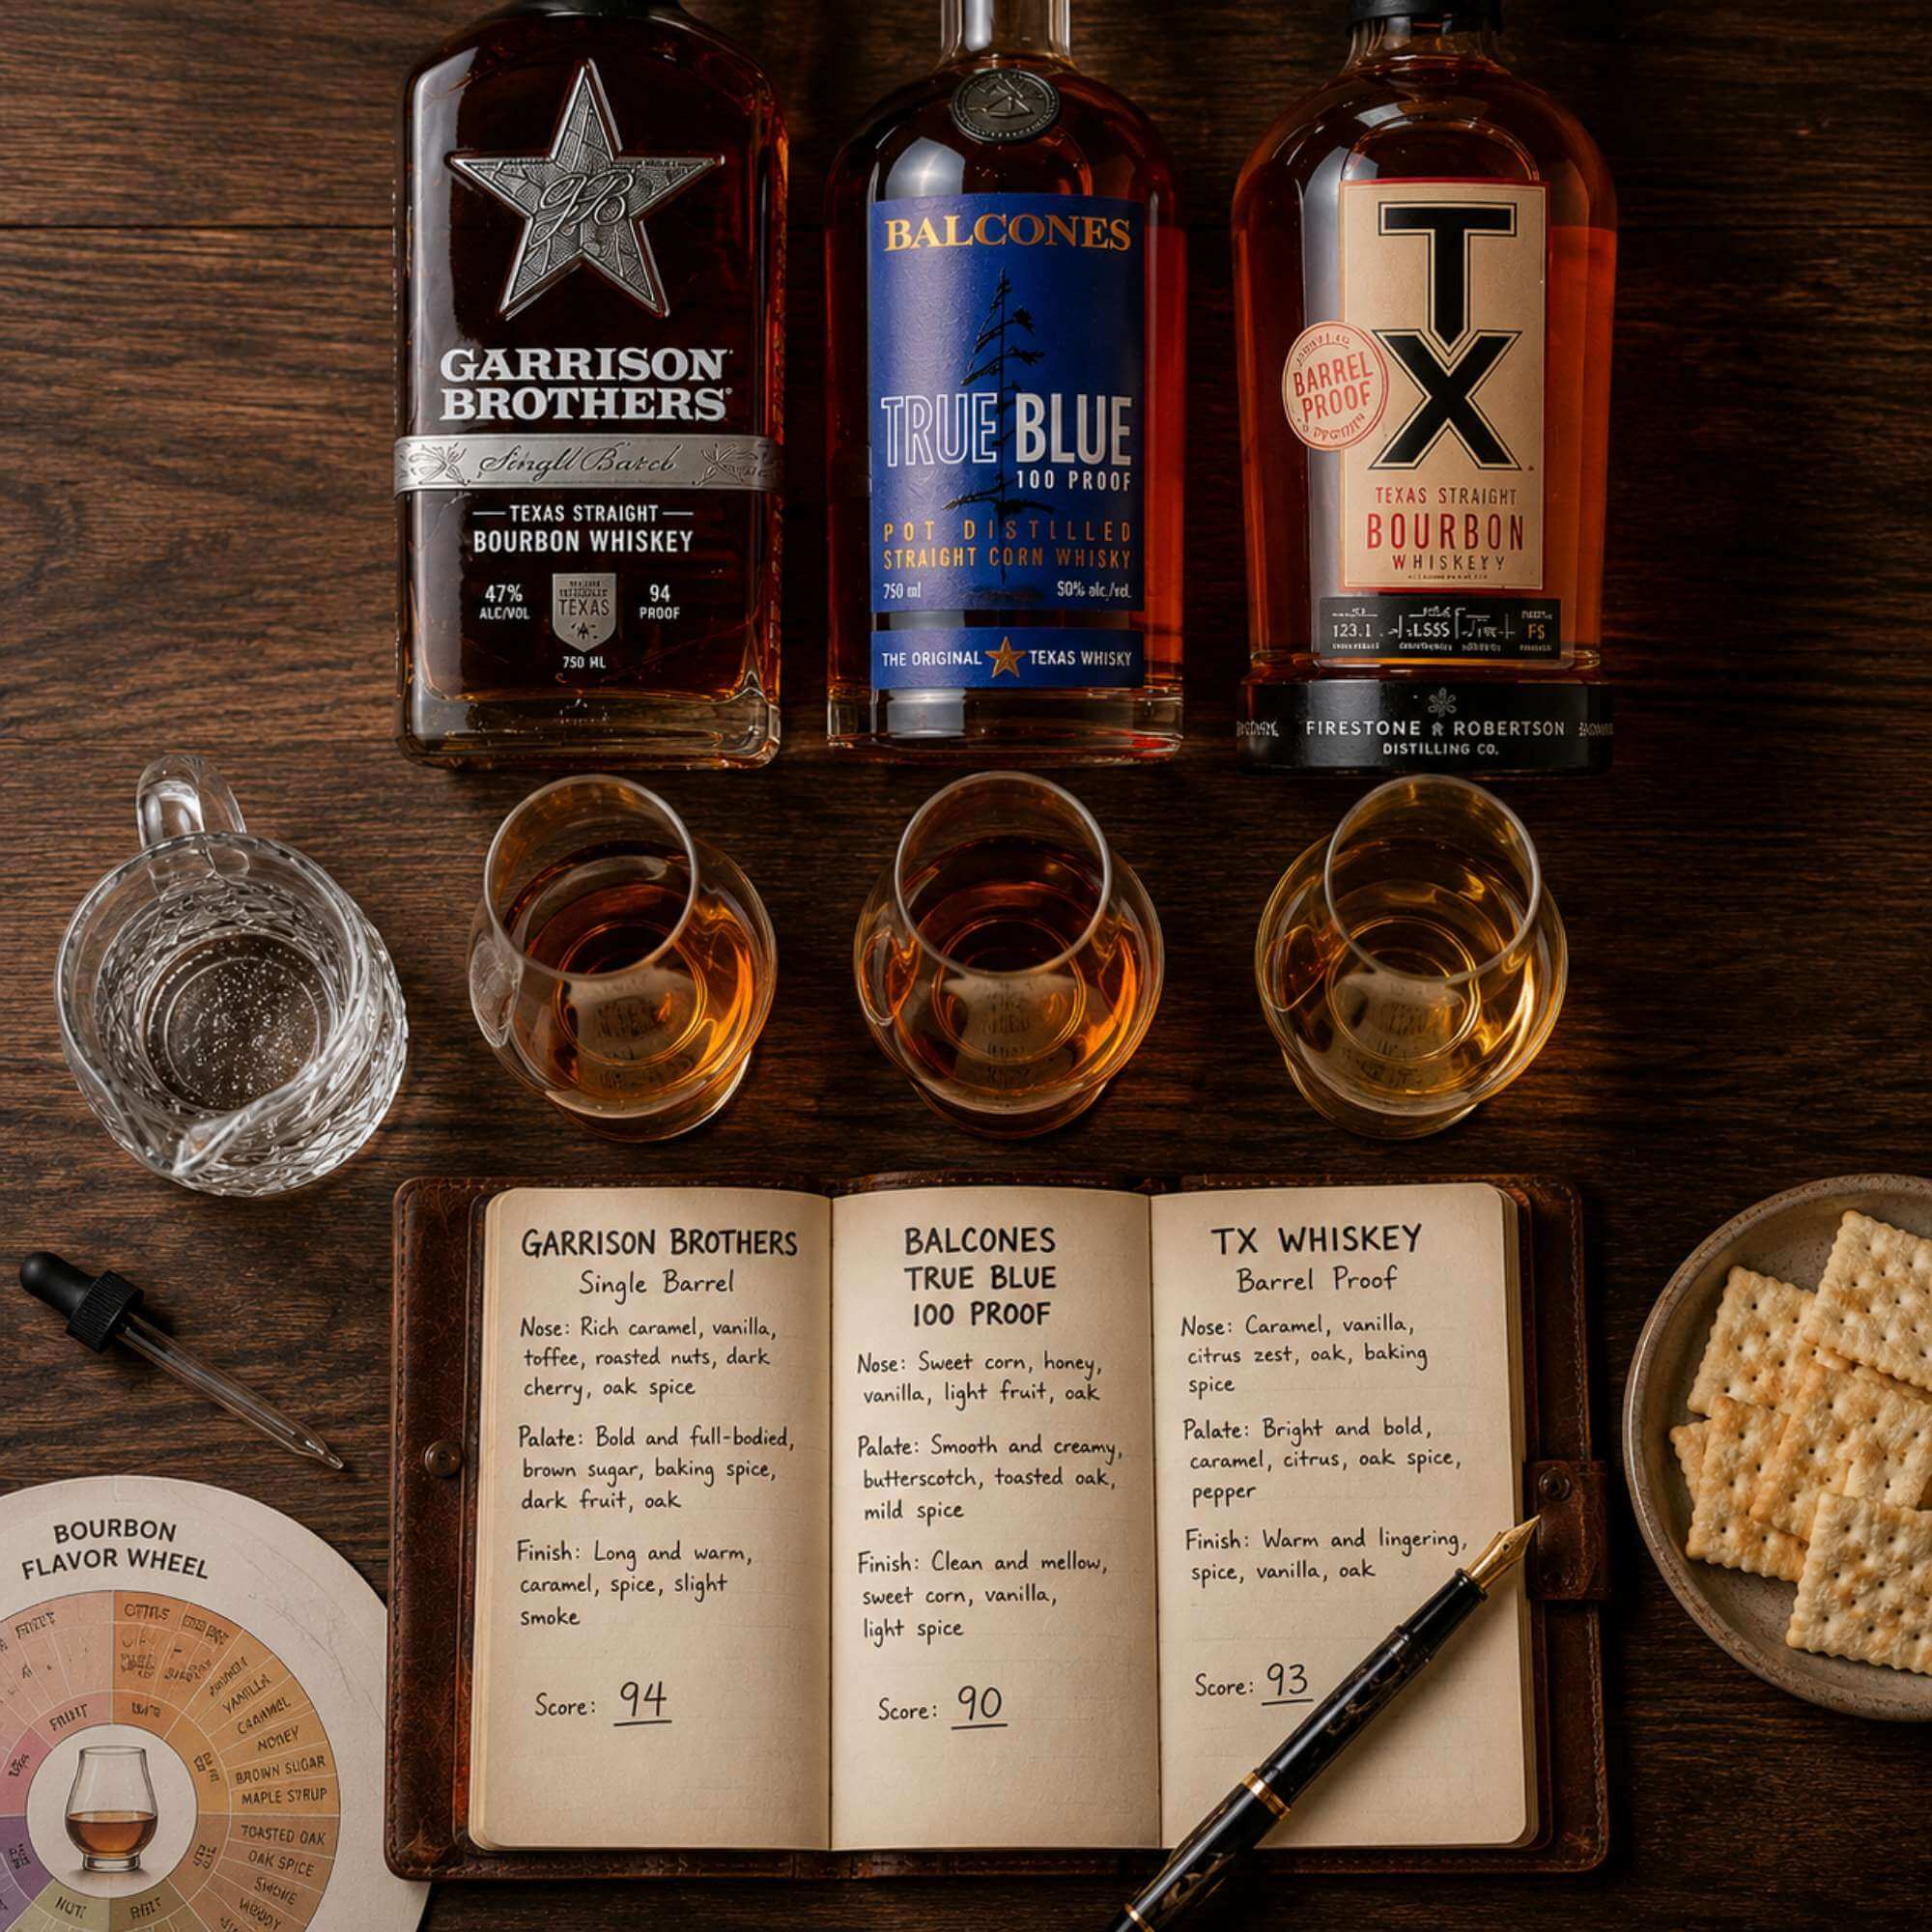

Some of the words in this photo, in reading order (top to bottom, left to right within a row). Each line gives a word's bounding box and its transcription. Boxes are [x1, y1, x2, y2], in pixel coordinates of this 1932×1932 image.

[884, 213, 1132, 252] BALCONES
[440, 347, 727, 383] GARRISON
[1293, 351, 1374, 398] BARREL
[440, 387, 727, 421] BROTHERS
[1301, 381, 1371, 423] PROOF
[880, 392, 998, 468] TRUE
[1015, 392, 1132, 467] BLUE
[1016, 469, 1055, 489] 100
[1068, 470, 1131, 492] PROOF
[1376, 487, 1427, 504] TEXAS
[1437, 487, 1518, 506] STRAIGHT
[509, 505, 564, 523] TEXAS
[573, 504, 660, 523] STRAIGHT
[472, 530, 580, 553] BOURBON
[589, 530, 694, 553] WHISKEY
[884, 521, 935, 542] POT
[963, 520, 1131, 543] DISTILLED
[1366, 512, 1524, 551] BOURBON
[883, 547, 978, 570] STRAIGHT
[989, 547, 1043, 567] CORN
[1055, 549, 1131, 570] WHISKY
[484, 584, 524, 604] 47%
[649, 584, 670, 604] 94
[883, 583, 904, 599] 750
[1057, 581, 1086, 598] 50%
[479, 606, 530, 620] ALC/VOL
[558, 599, 610, 616] TEXAS
[639, 607, 680, 620] PROOF
[1332, 623, 1373, 638] 123.1
[562, 656, 585, 668] 750
[882, 652, 907, 667] THE
[912, 650, 982, 666] ORIGINAL
[1029, 649, 1076, 665] TEXAS
[1080, 650, 1132, 667] WHISKY
[1305, 720, 1421, 736] FIRESTONE
[1453, 721, 1565, 736] ROBERTSON
[1382, 742, 1470, 755] DISTILLING
[1477, 742, 1499, 755] CO.
[521, 1228, 656, 1258] GARRISON
[670, 1227, 799, 1257] BROTHERS
[904, 1226, 1056, 1256] BALCONES
[1210, 1226, 1259, 1255] TX
[1277, 1223, 1422, 1253] WHISKEY
[579, 1269, 648, 1305] Single
[663, 1268, 734, 1293] Barrel
[904, 1265, 975, 1292] TRUE
[990, 1264, 1057, 1290] BLUE
[1236, 1266, 1314, 1293] Barrel
[1333, 1264, 1399, 1291] Proof
[914, 1303, 954, 1327] 100
[971, 1301, 1052, 1326] PROOF
[1180, 1315, 1233, 1337] Nose:
[1245, 1313, 1331, 1337] Caramel,
[1343, 1312, 1414, 1335] vanilla,
[520, 1316, 570, 1338] Nose:
[581, 1316, 619, 1336] Rich
[628, 1317, 704, 1340] caramel,
[712, 1316, 777, 1341] vanilla,
[524, 1347, 586, 1370] toffee,
[595, 1346, 661, 1366] roasted
[670, 1348, 717, 1370] nuts,
[725, 1347, 771, 1365] dark
[857, 1351, 905, 1375] Nose:
[918, 1350, 973, 1372] Sweet
[984, 1356, 1034, 1374] corn,
[1043, 1350, 1102, 1380] honey,
[1187, 1347, 1241, 1365] citrus
[1254, 1345, 1300, 1366] zest,
[1311, 1344, 1353, 1365] oak,
[1364, 1342, 1428, 1372] baking
[524, 1377, 592, 1406] cherry,
[603, 1377, 638, 1395] oak
[649, 1378, 696, 1404] spice
[864, 1382, 932, 1406] vanilla,
[945, 1381, 988, 1411] light
[1000, 1378, 1055, 1405] fruit,
[1065, 1383, 1101, 1401] oak
[1188, 1376, 1236, 1401] spice
[518, 1425, 583, 1448] Palate:
[595, 1425, 635, 1447] Bold
[645, 1426, 678, 1446] and
[690, 1424, 794, 1452] full-bodied,
[1182, 1417, 1249, 1440] Palate:
[1262, 1416, 1323, 1447] Bright
[1335, 1416, 1370, 1436] and
[1382, 1415, 1433, 1439] bold,
[857, 1435, 919, 1459] Palate:
[930, 1434, 998, 1456] Smooth
[1009, 1434, 1042, 1454] and
[1053, 1440, 1123, 1466] creamy,
[1190, 1448, 1273, 1472] caramel,
[1283, 1450, 1348, 1471] citrus,
[1359, 1448, 1396, 1465] oak
[1406, 1451, 1462, 1474] spice,
[523, 1458, 577, 1478] brown
[587, 1463, 644, 1488] sugar,
[655, 1457, 715, 1488] baking
[725, 1460, 777, 1485] spice,
[864, 1467, 984, 1491] butterscotch,
[994, 1466, 1063, 1486] toasted
[1075, 1467, 1116, 1491] oak,
[521, 1490, 568, 1510] dark
[580, 1488, 634, 1514] fruit,
[644, 1490, 682, 1509] oak
[1192, 1484, 1257, 1508] pepper
[864, 1499, 903, 1521] mild
[917, 1501, 965, 1526] spice
[53, 1518, 177, 1544] BOURBON
[1185, 1527, 1249, 1551] Finish:
[1262, 1528, 1319, 1548] Warm
[1330, 1527, 1366, 1548] and
[1378, 1526, 1468, 1557] lingering,
[21, 1548, 119, 1580] FLAVOR
[127, 1547, 210, 1579] WHEEL
[517, 1539, 581, 1562] Finish:
[594, 1540, 637, 1572] Long
[647, 1540, 682, 1561] and
[694, 1548, 753, 1566] warm,
[857, 1549, 919, 1575] Finish:
[931, 1549, 983, 1572] Clean
[994, 1548, 1029, 1571] and
[1040, 1549, 1108, 1575] mellow,
[1191, 1563, 1245, 1589] spice,
[1256, 1558, 1328, 1582] vanilla,
[1339, 1558, 1377, 1578] oak
[520, 1573, 599, 1597] caramel,
[611, 1577, 664, 1602] spice,
[674, 1572, 728, 1603] slight
[862, 1586, 914, 1605] sweet
[925, 1590, 973, 1607] corn,
[984, 1582, 1057, 1606] vanilla,
[520, 1605, 581, 1627] smoke
[864, 1617, 905, 1648] light
[917, 1621, 965, 1645] spice
[1195, 1673, 1254, 1697] Score:
[1266, 1662, 1309, 1696] 93
[534, 1691, 596, 1717] Score:
[620, 1680, 668, 1718] 94
[878, 1696, 938, 1721] Score:
[957, 1685, 1002, 1721] 90
[236, 1764, 280, 1784] BROWN
[285, 1755, 326, 1774] SUGAR
[242, 1789, 282, 1805] MAPLE
[241, 1824, 295, 1843] TOASTED
[299, 1831, 327, 1846] OAK
[248, 1850, 274, 1868] OAK
[277, 1857, 316, 1877] SPICE
